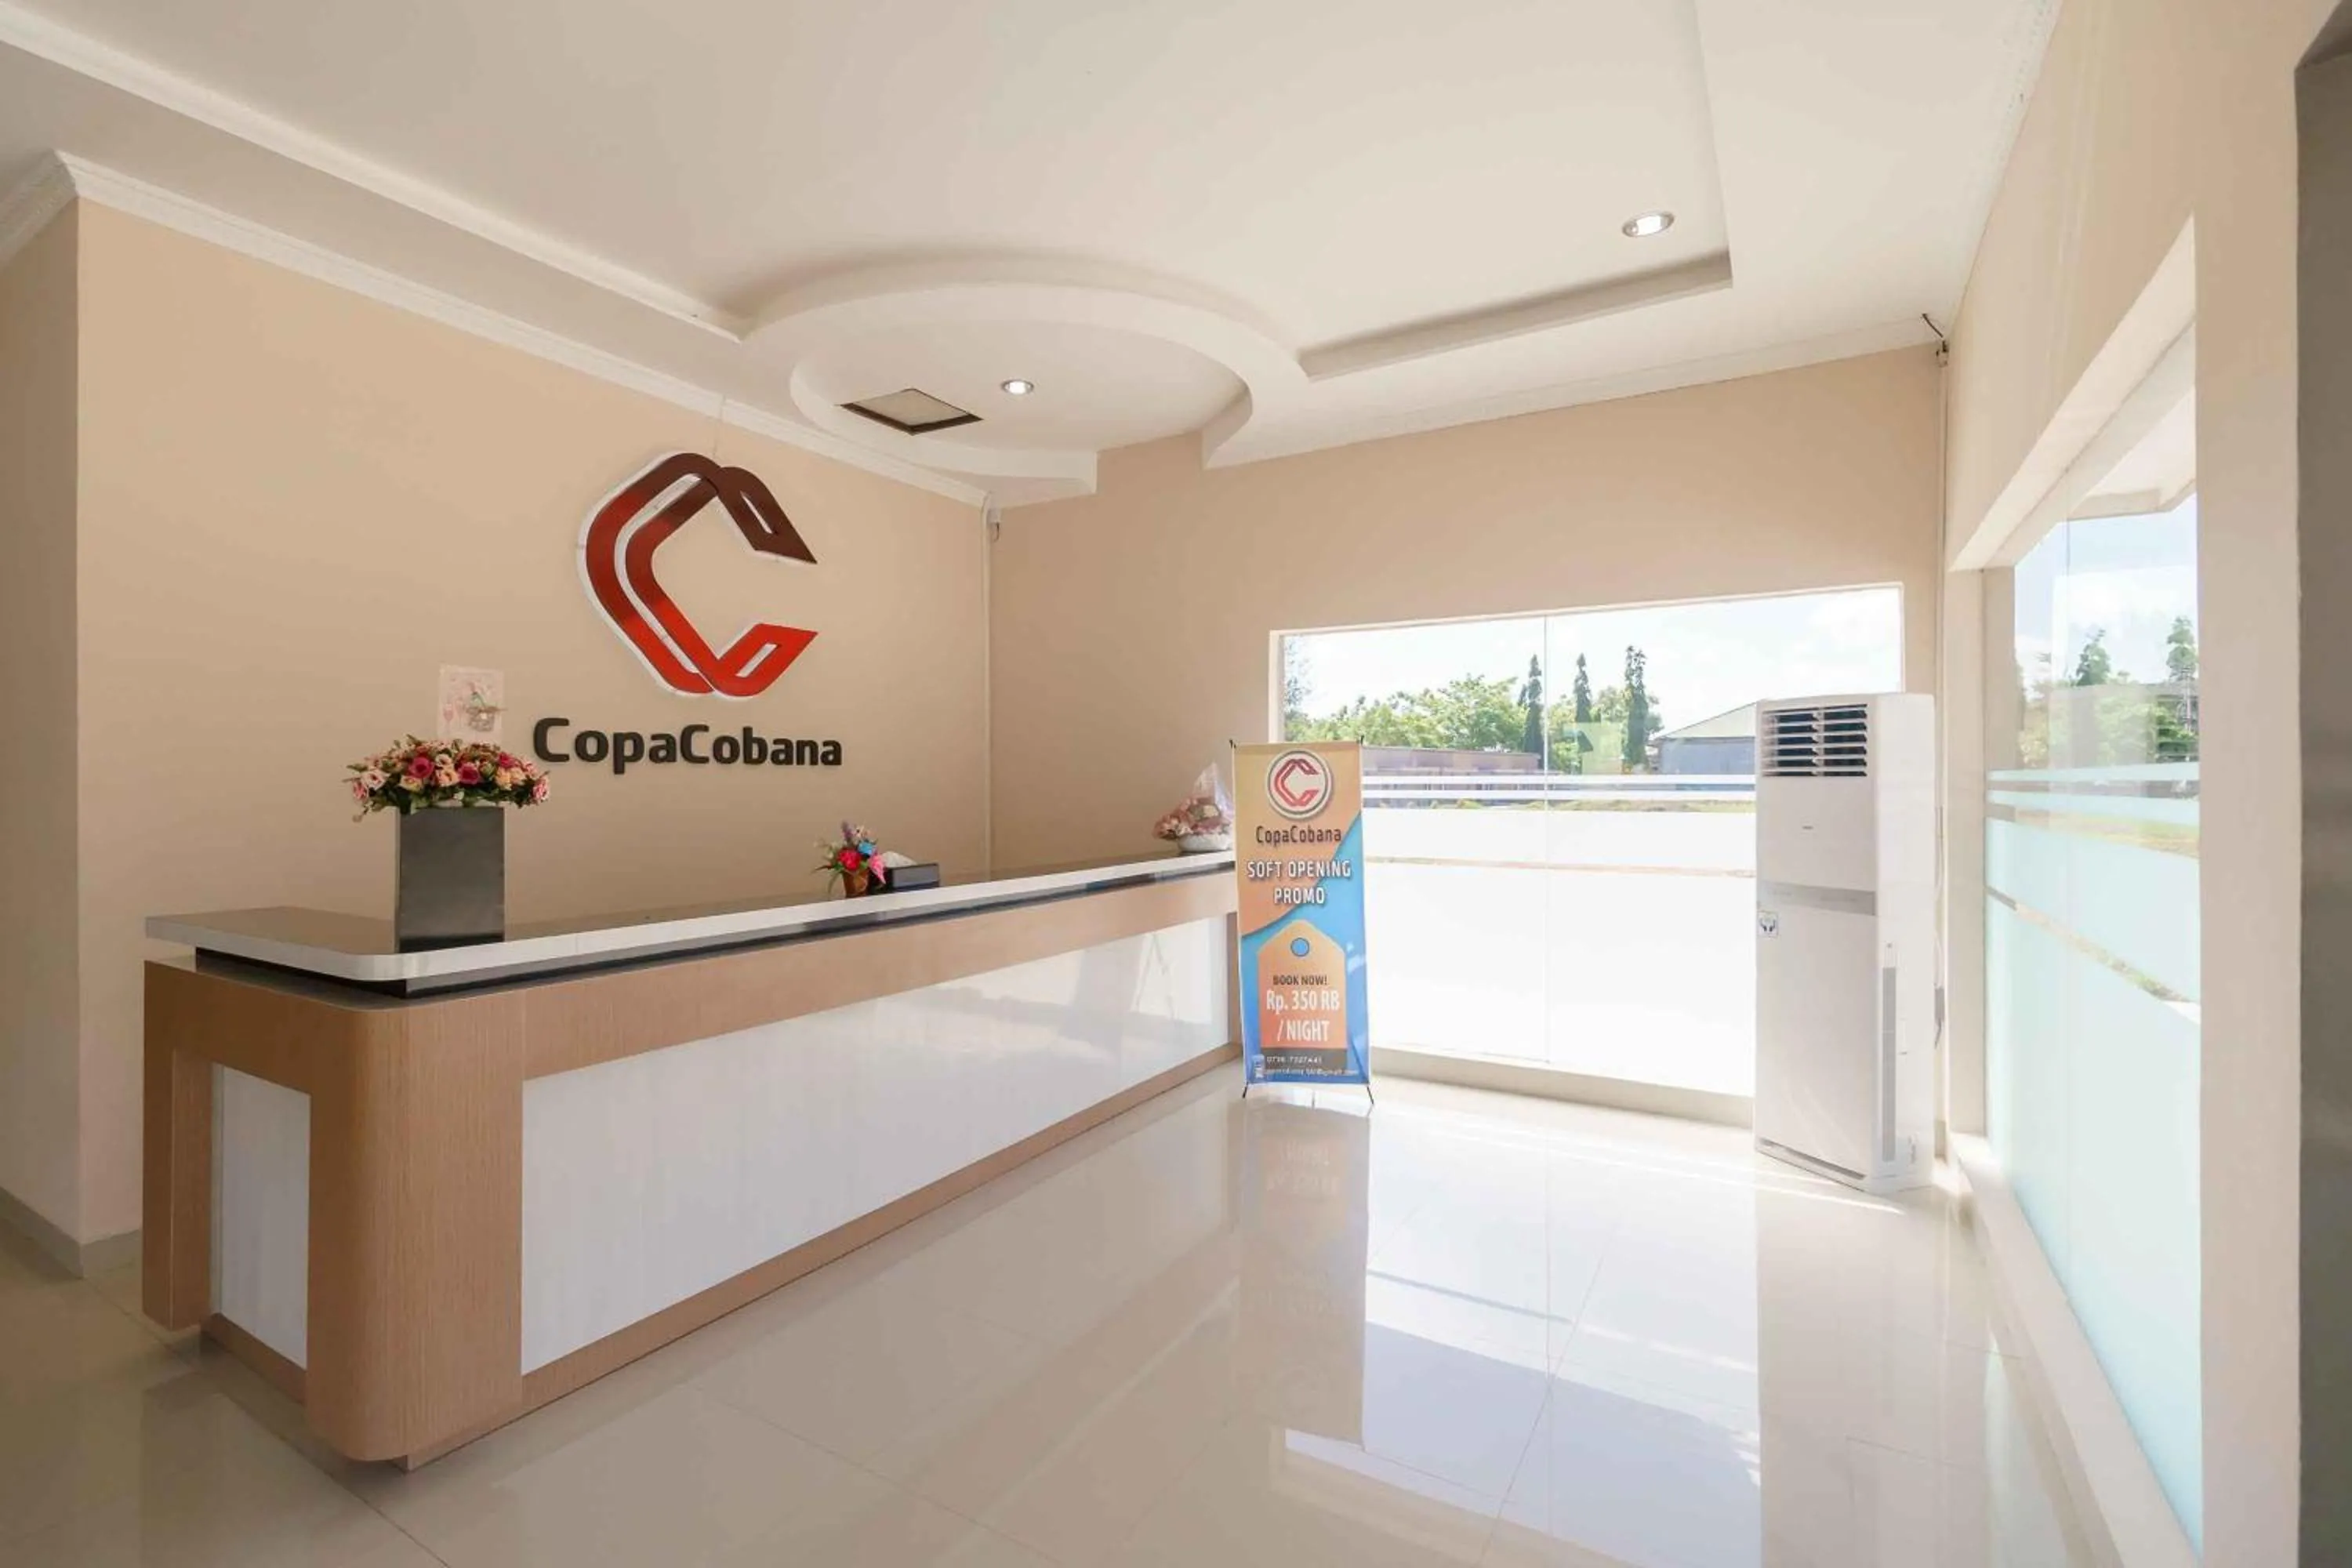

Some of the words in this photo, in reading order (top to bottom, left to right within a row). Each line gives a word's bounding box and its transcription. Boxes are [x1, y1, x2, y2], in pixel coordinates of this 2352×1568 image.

[533, 717, 842, 775] CopaCobana
[1256, 826, 1341, 848] CopaCobana
[1247, 862, 1282, 878] SOFT
[1288, 861, 1351, 877] OPENING
[1274, 887, 1324, 904] PROMO
[1272, 975, 1299, 985] BOOK
[1301, 975, 1327, 985] NOW!
[1266, 989, 1288, 1014] Rp.
[1291, 989, 1317, 1011] 350
[1321, 989, 1340, 1011] RB
